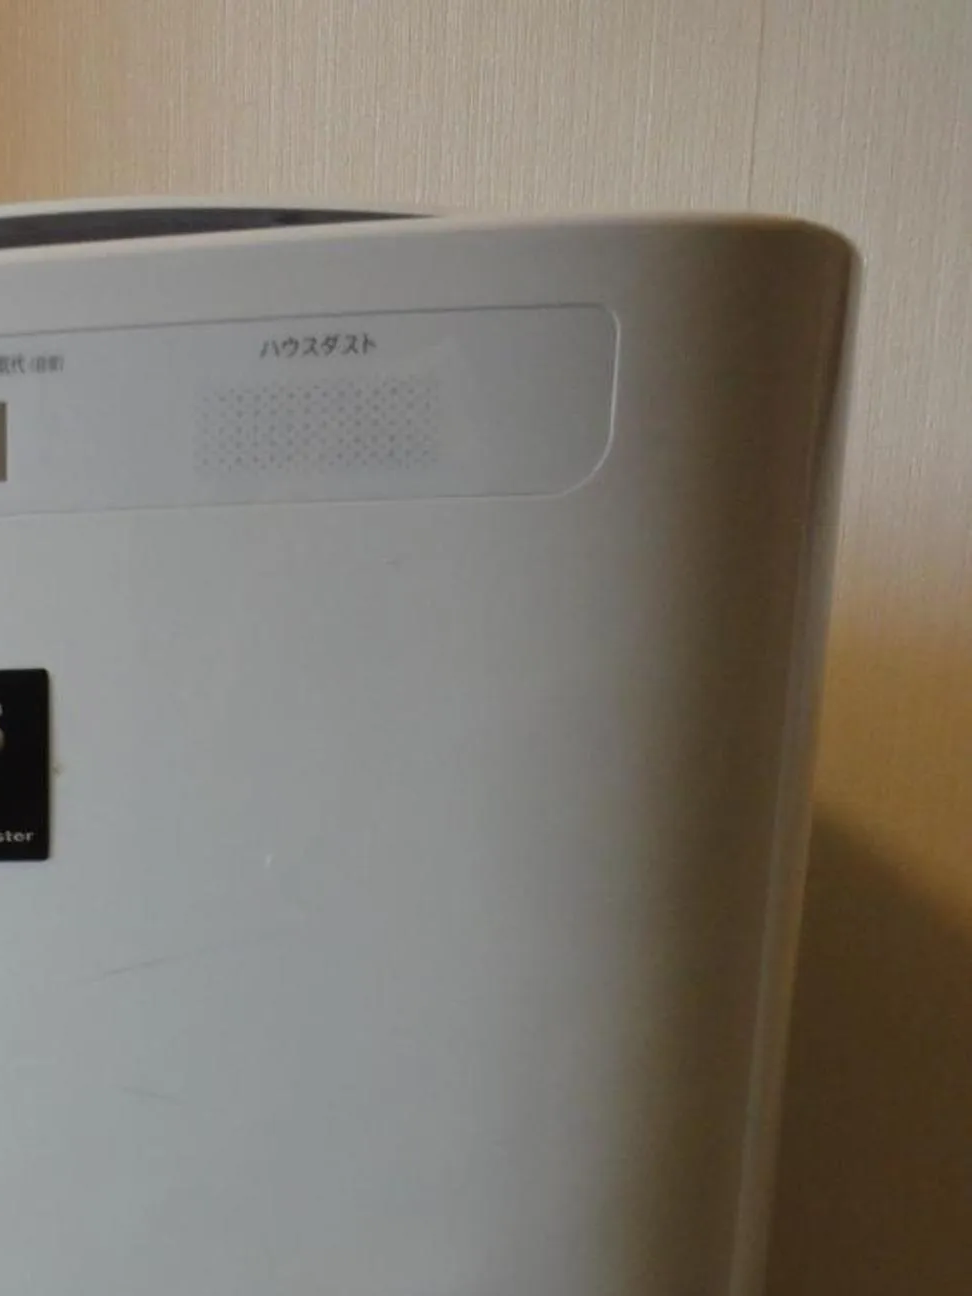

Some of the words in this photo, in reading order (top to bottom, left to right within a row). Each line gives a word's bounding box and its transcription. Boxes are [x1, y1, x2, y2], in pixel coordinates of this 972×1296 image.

[259, 333, 377, 358] ハウスダスト
